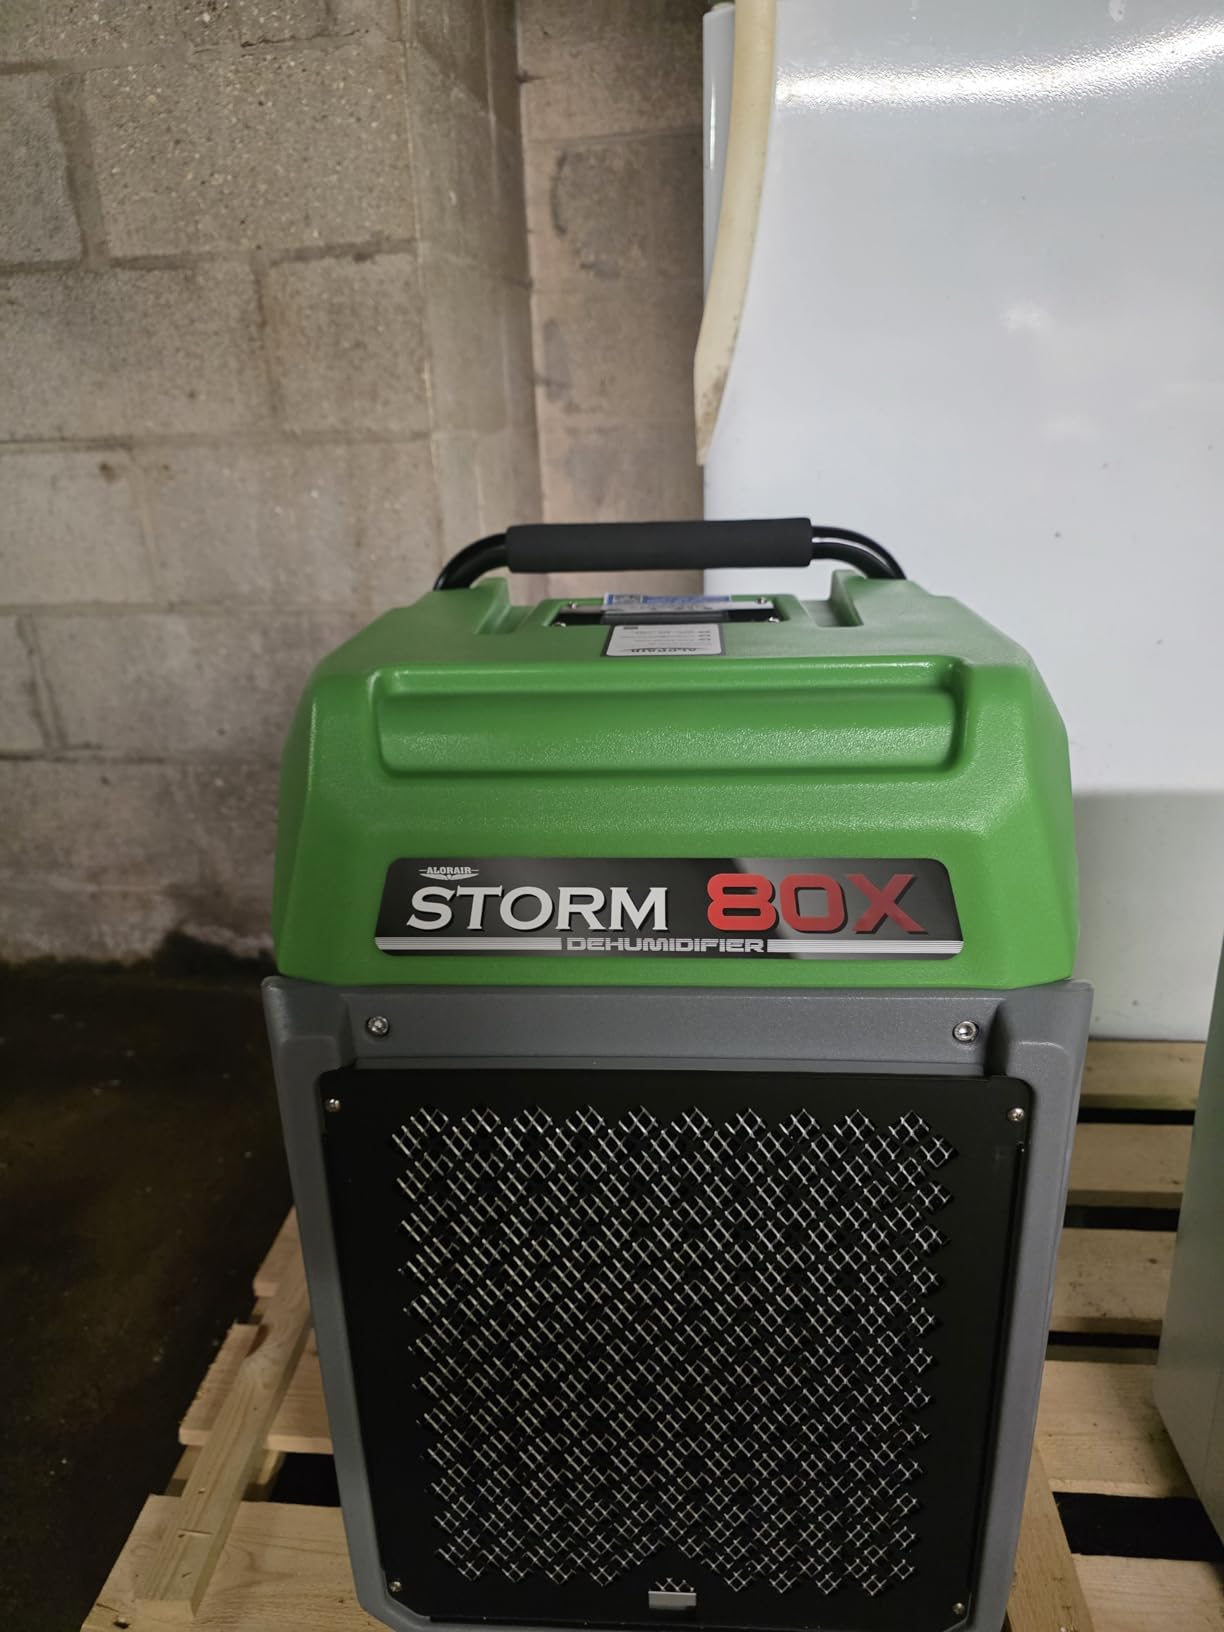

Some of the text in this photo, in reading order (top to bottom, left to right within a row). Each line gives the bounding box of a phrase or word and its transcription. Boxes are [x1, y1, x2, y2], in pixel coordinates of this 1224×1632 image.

[426, 866, 472, 874] ALORAIR
[406, 873, 926, 933] STORM 80X
[566, 937, 765, 953] DEHUMIDIFIER
